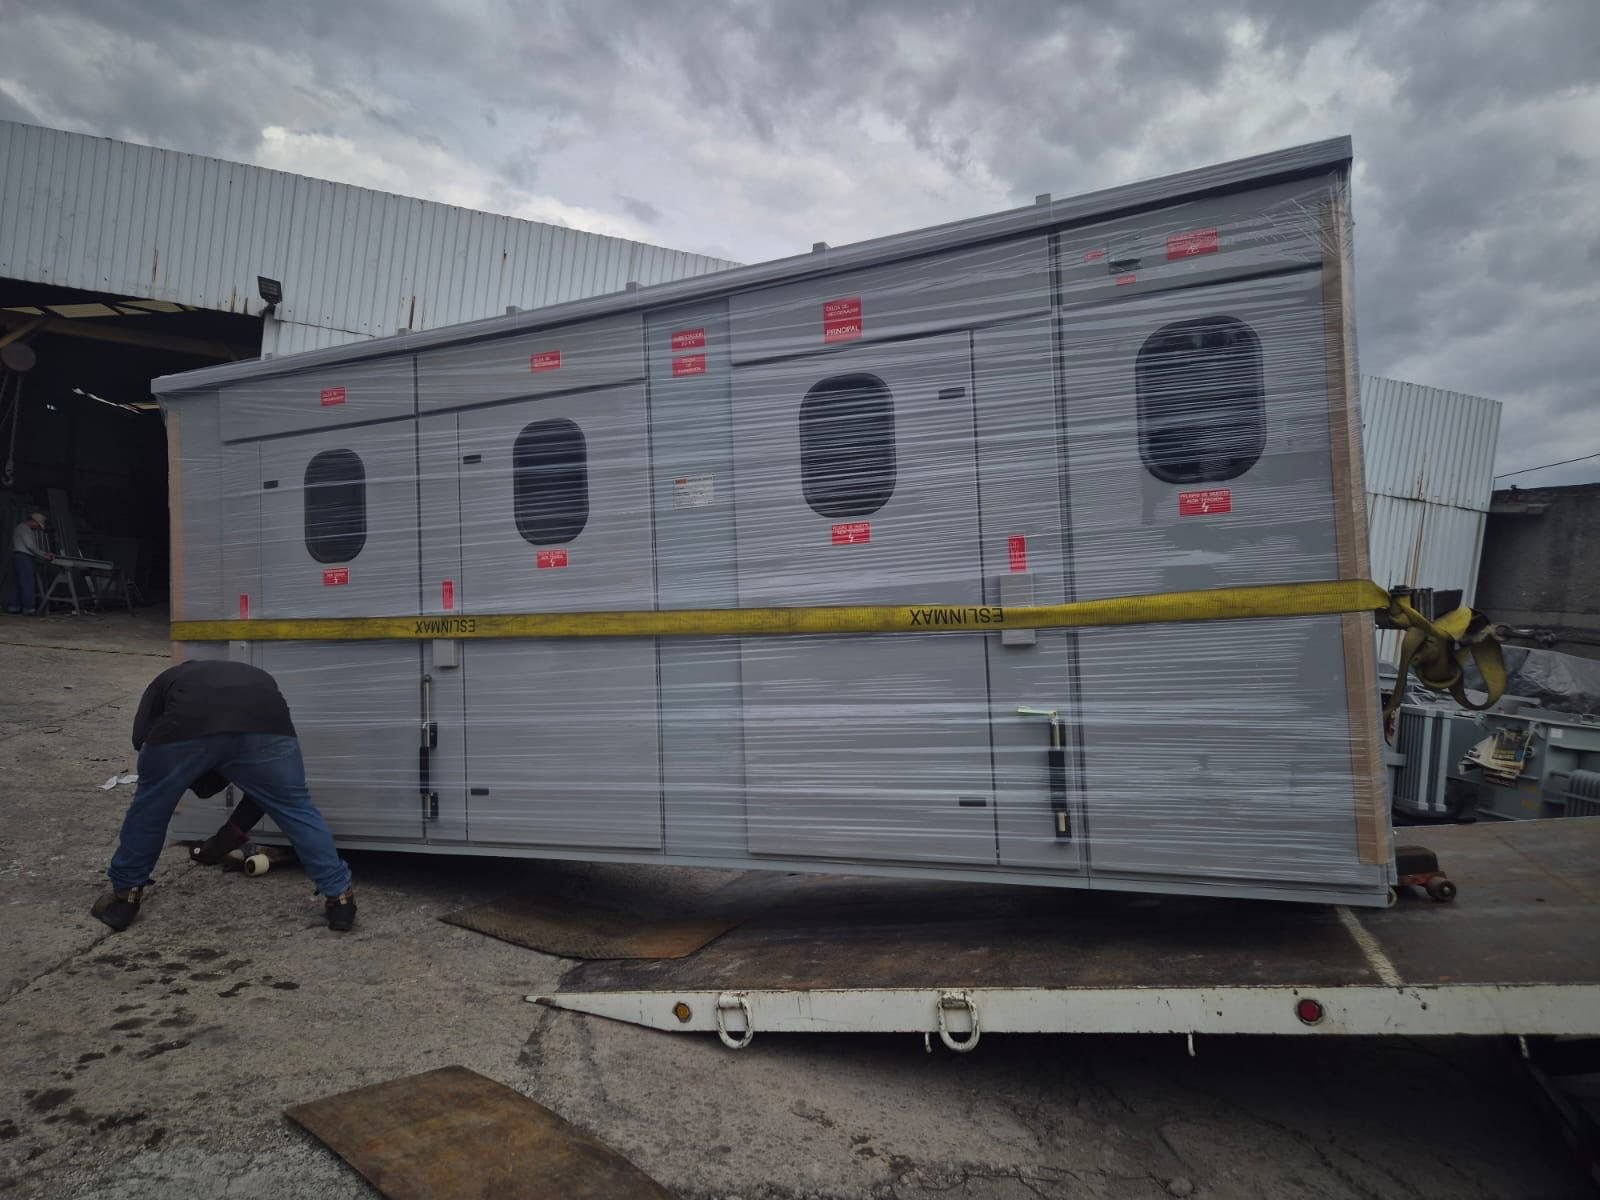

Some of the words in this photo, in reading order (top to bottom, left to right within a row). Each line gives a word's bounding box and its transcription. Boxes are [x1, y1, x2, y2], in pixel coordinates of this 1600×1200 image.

[826, 324, 859, 337] PRINCIPAL
[910, 607, 1004, 625] ESLINMAX
[415, 619, 476, 634] ESLINMAX
